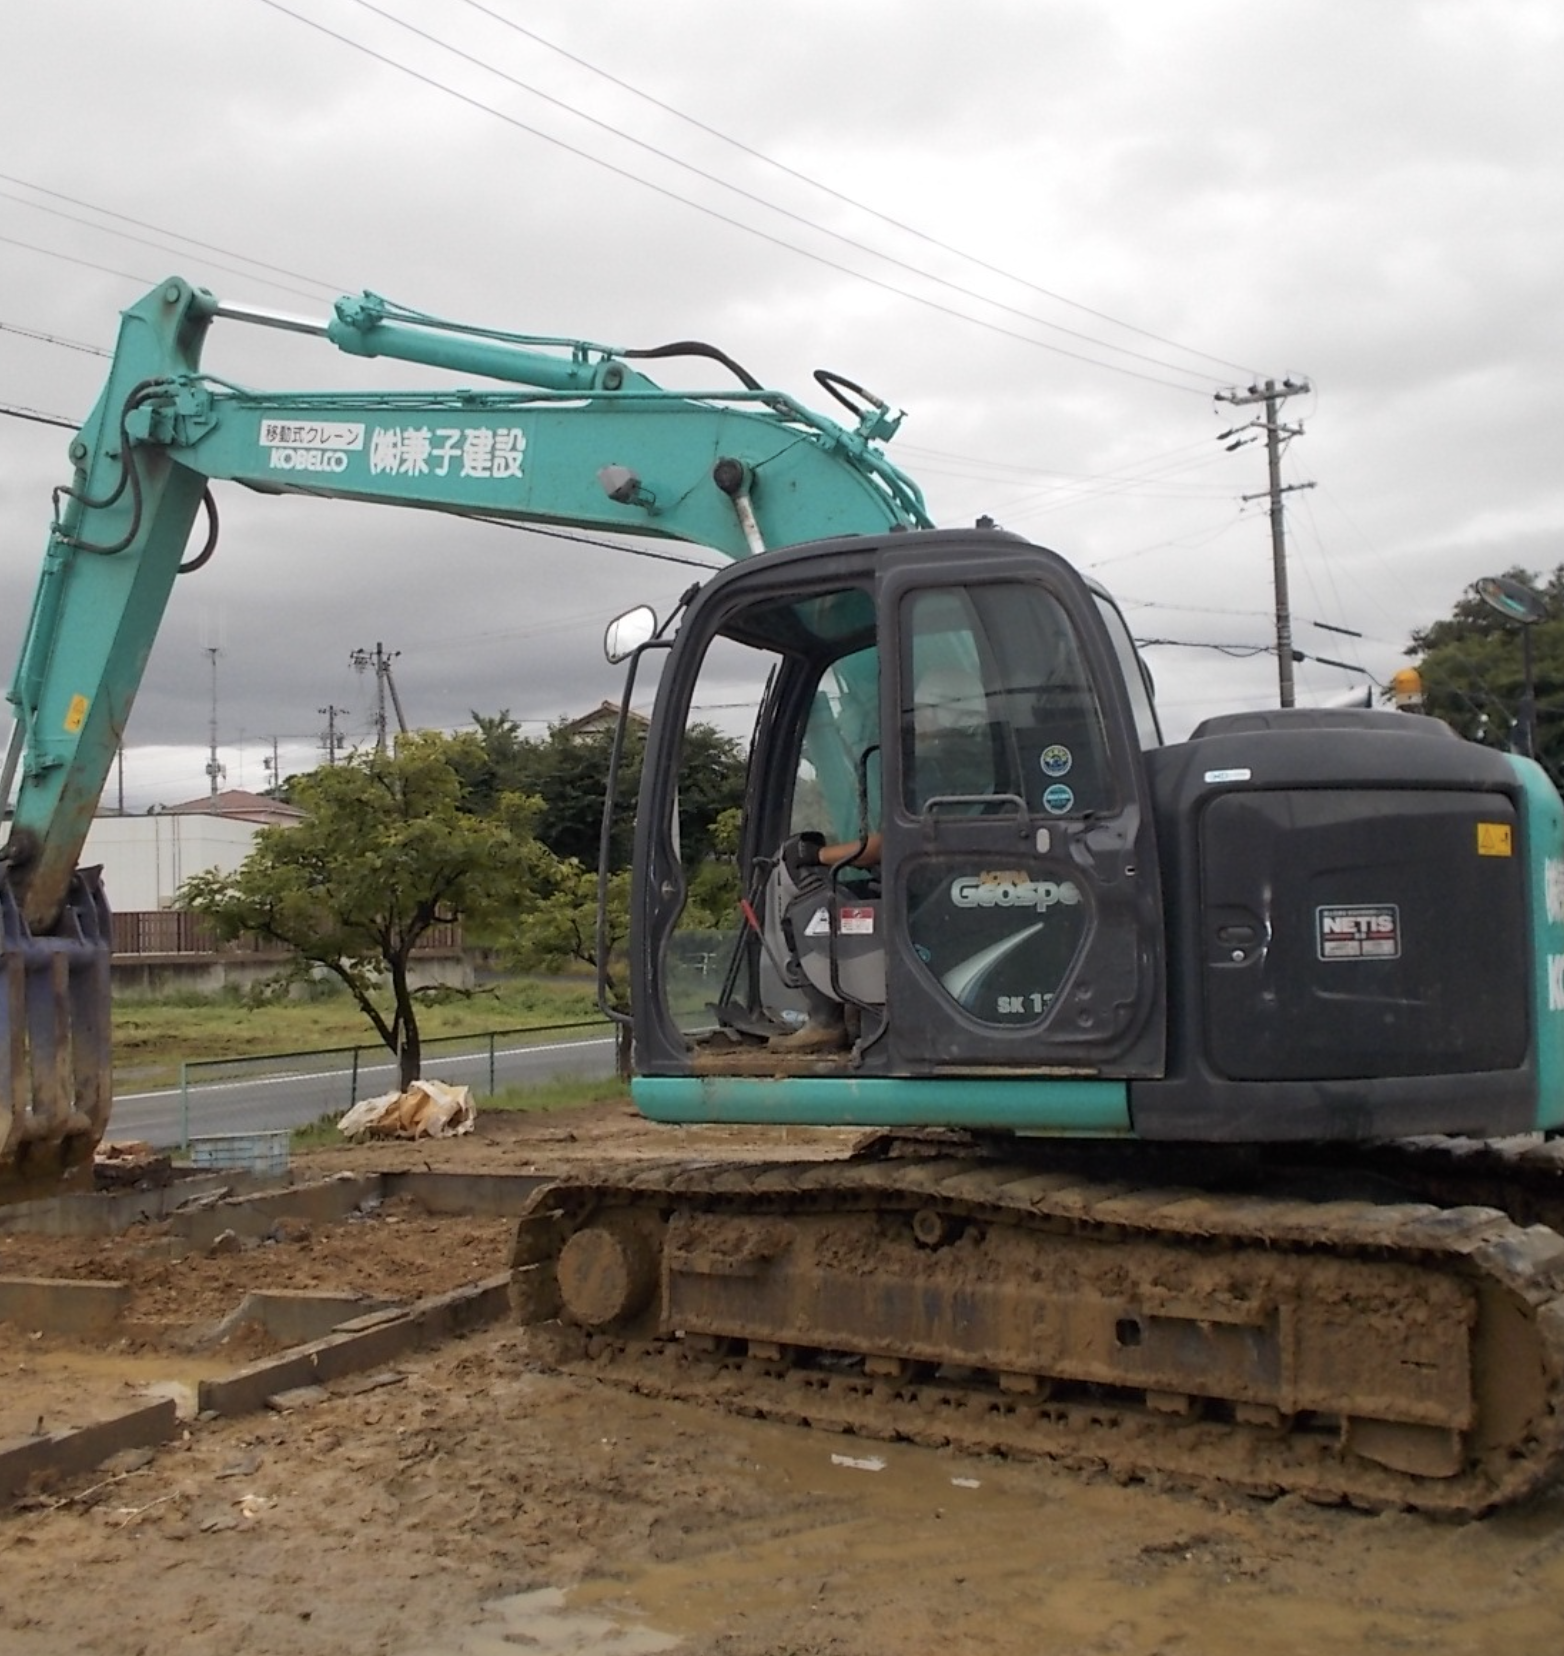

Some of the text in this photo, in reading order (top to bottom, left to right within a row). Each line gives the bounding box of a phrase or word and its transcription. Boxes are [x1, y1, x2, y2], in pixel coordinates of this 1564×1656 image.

[266, 424, 360, 446] 移動式クレーン
[269, 447, 348, 472] KOBELCO
[1323, 915, 1394, 934] NETIS
[997, 996, 1026, 1014] SK
